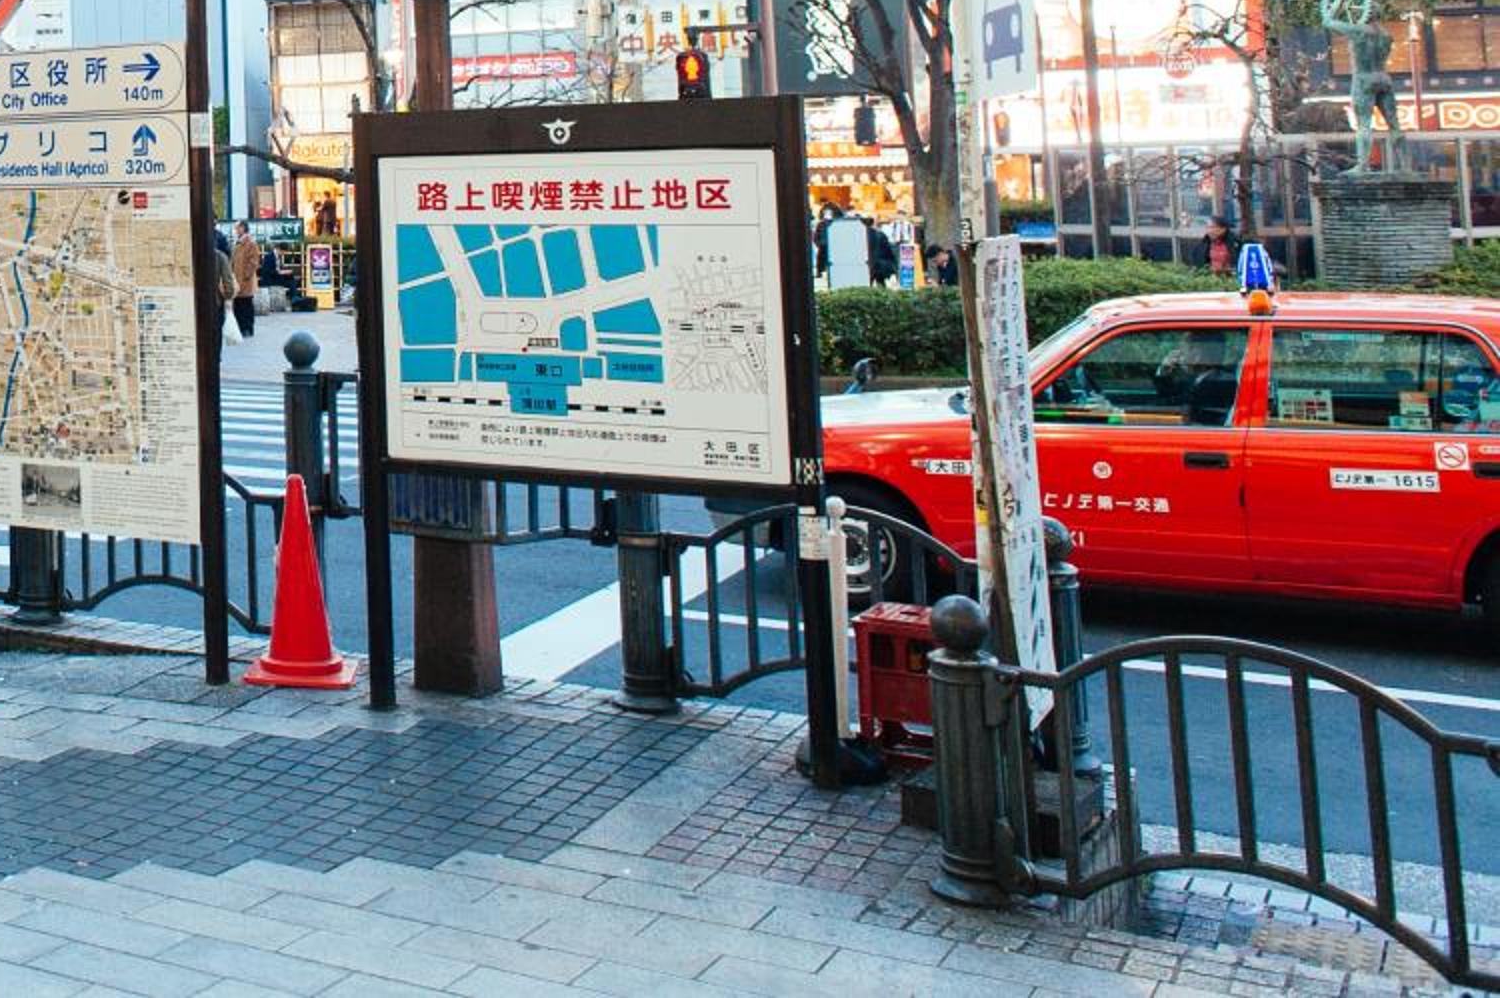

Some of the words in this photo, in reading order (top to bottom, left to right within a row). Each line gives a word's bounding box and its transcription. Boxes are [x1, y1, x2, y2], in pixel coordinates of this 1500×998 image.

[123, 85, 164, 102] 140m
[1, 94, 25, 111] City
[31, 93, 69, 108] Office
[41, 161, 63, 176] Hall
[125, 159, 166, 175] 320m
[416, 178, 732, 213] 路上喫煙禁止地区
[703, 440, 761, 455] 大田区
[1393, 474, 1437, 489] 1615
